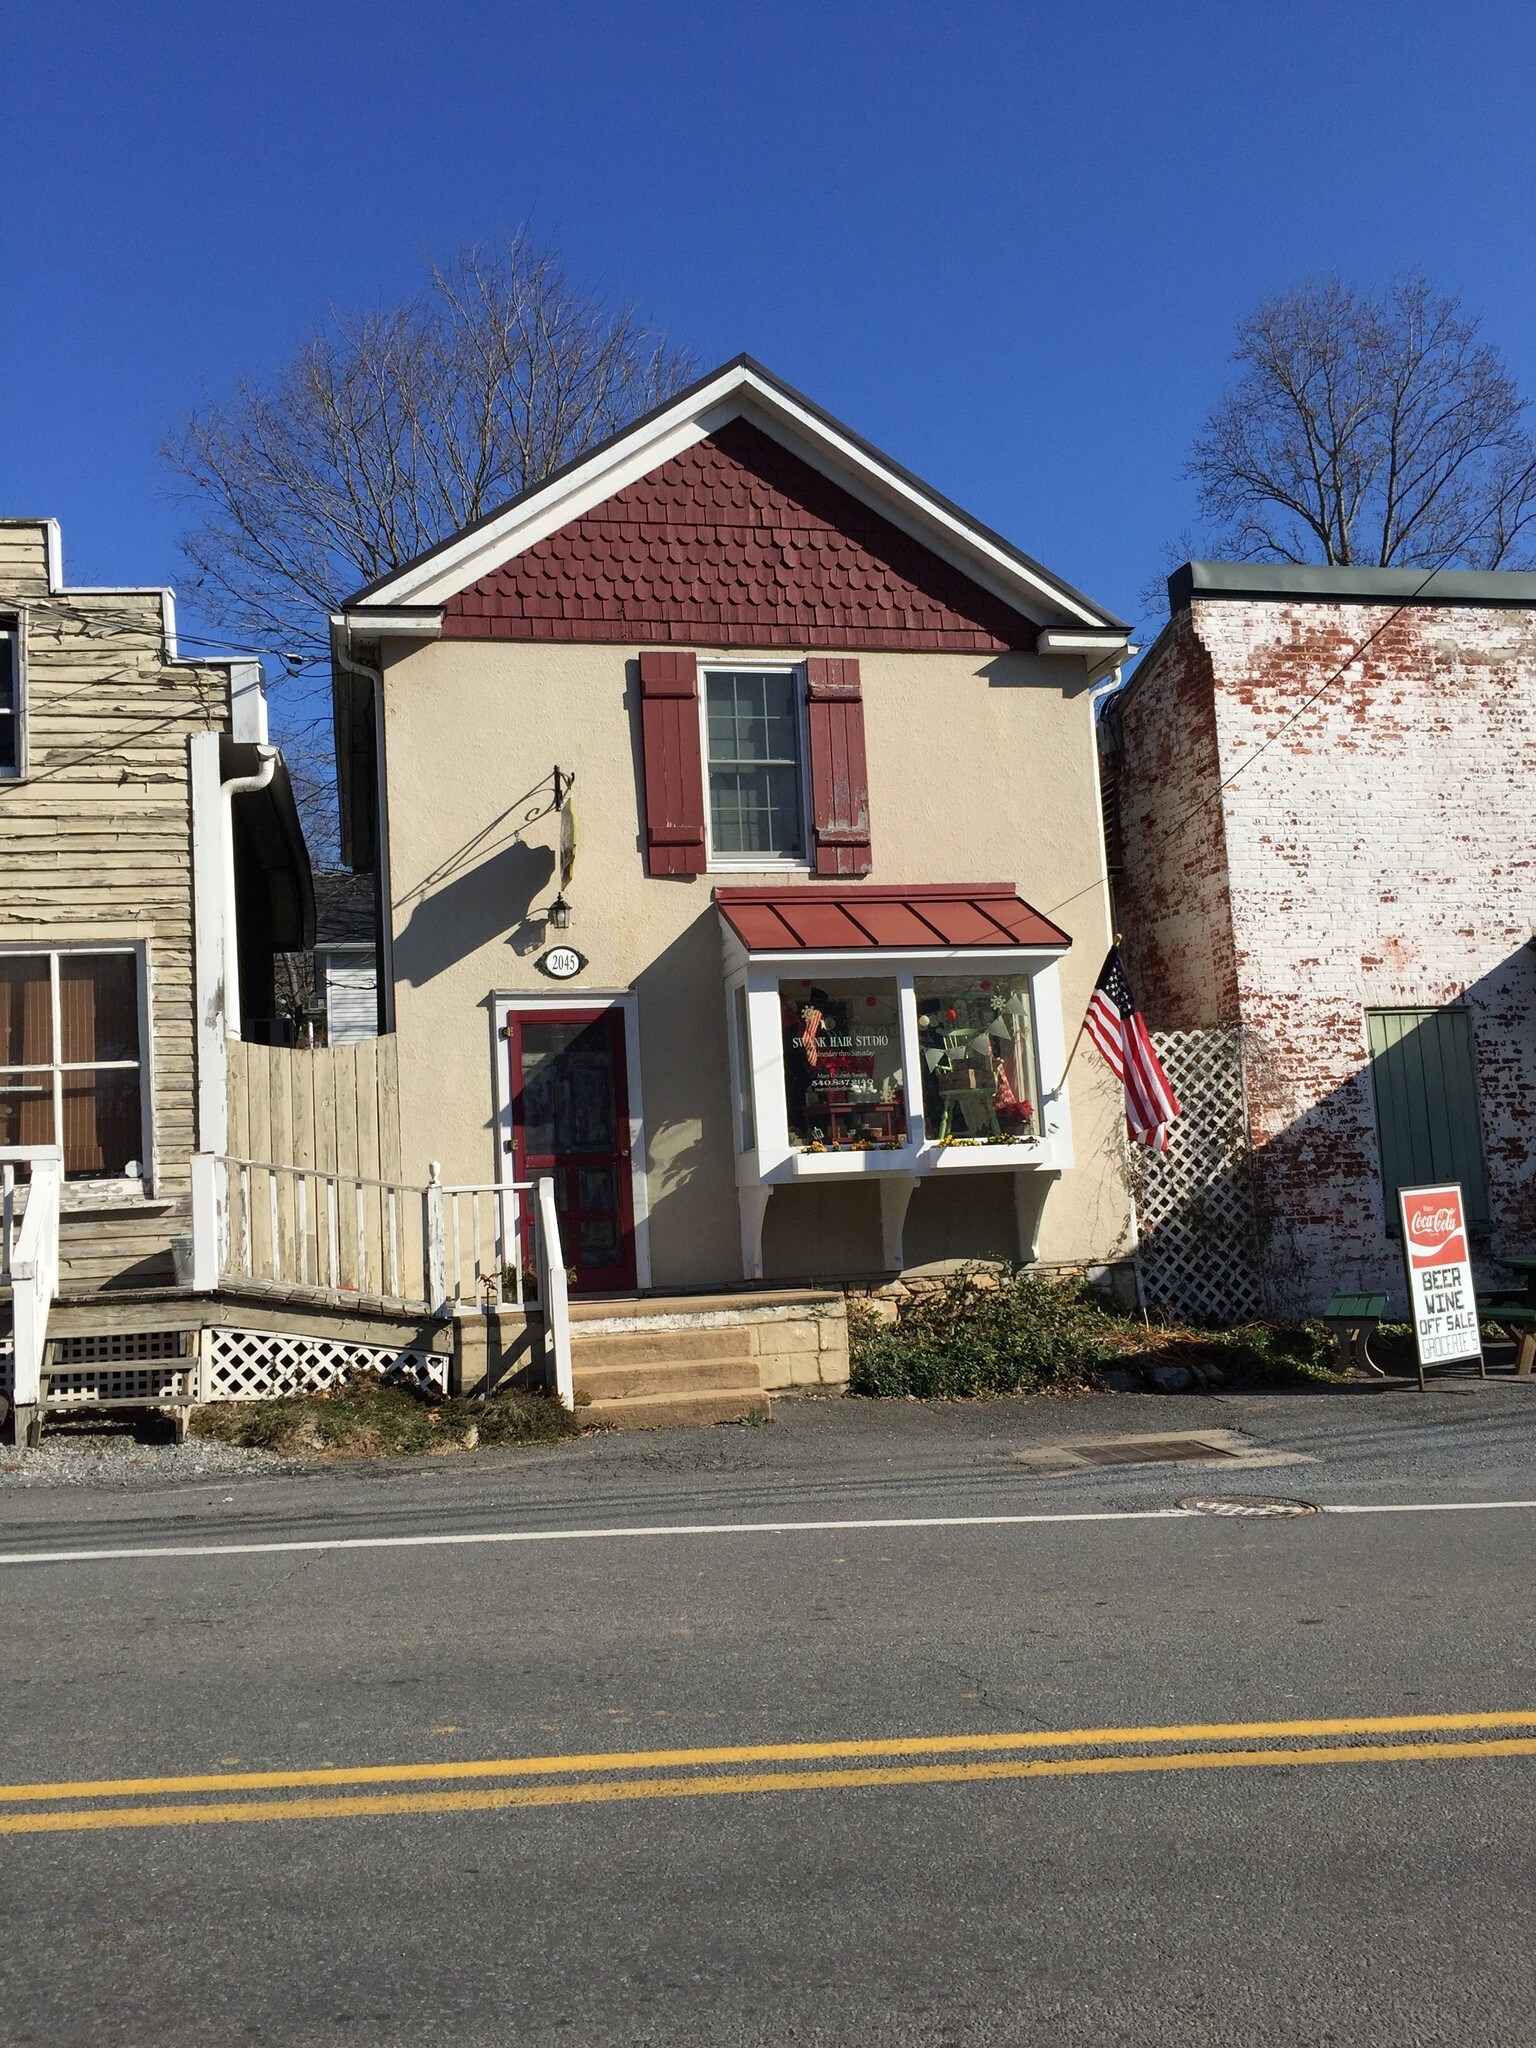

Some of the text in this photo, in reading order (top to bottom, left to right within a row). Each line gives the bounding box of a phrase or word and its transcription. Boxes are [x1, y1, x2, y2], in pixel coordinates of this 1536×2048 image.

[552, 954, 575, 970] 2045
[830, 1035, 852, 1047] HAIR
[856, 1035, 889, 1047] STUDIO
[851, 1049, 875, 1058] Saturday
[1411, 1207, 1456, 1235] Coca-Cola
[1421, 1267, 1462, 1291] BEER
[1424, 1290, 1465, 1315] WINE
[1419, 1311, 1475, 1336] OFF SALE
